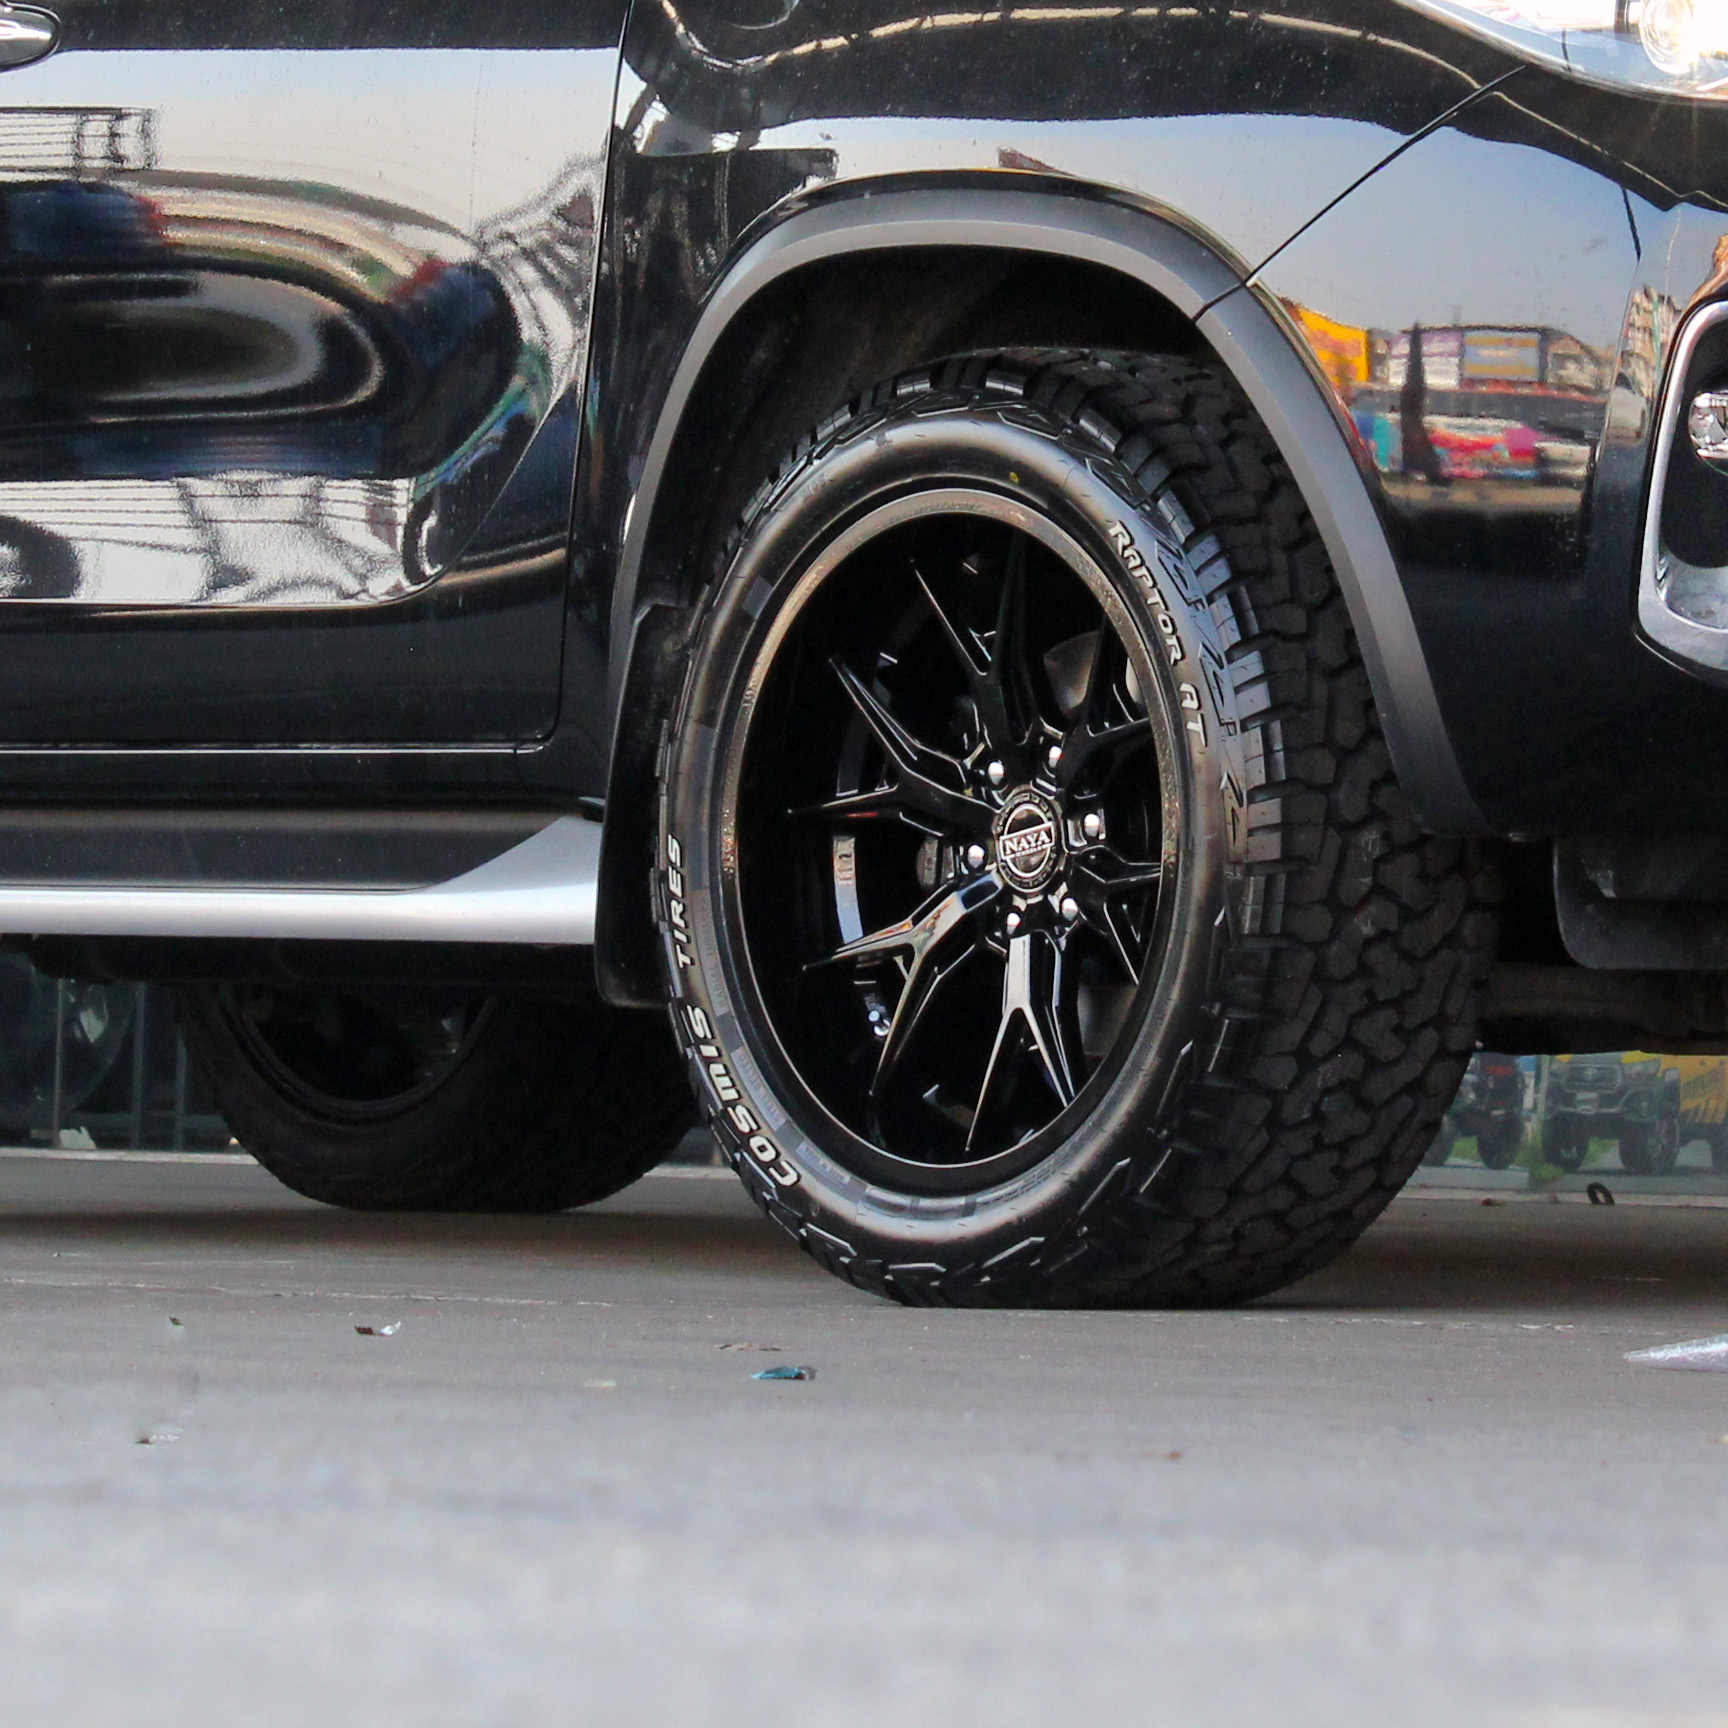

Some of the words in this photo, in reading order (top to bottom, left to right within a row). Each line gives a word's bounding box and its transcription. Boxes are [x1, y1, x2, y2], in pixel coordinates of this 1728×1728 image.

[1108, 520, 1184, 666] RAPTOR
[1180, 682, 1207, 747] AT
[667, 834, 693, 969] TIRES
[1005, 830, 1050, 854] NAYA
[686, 1004, 799, 1187] COSMIS
